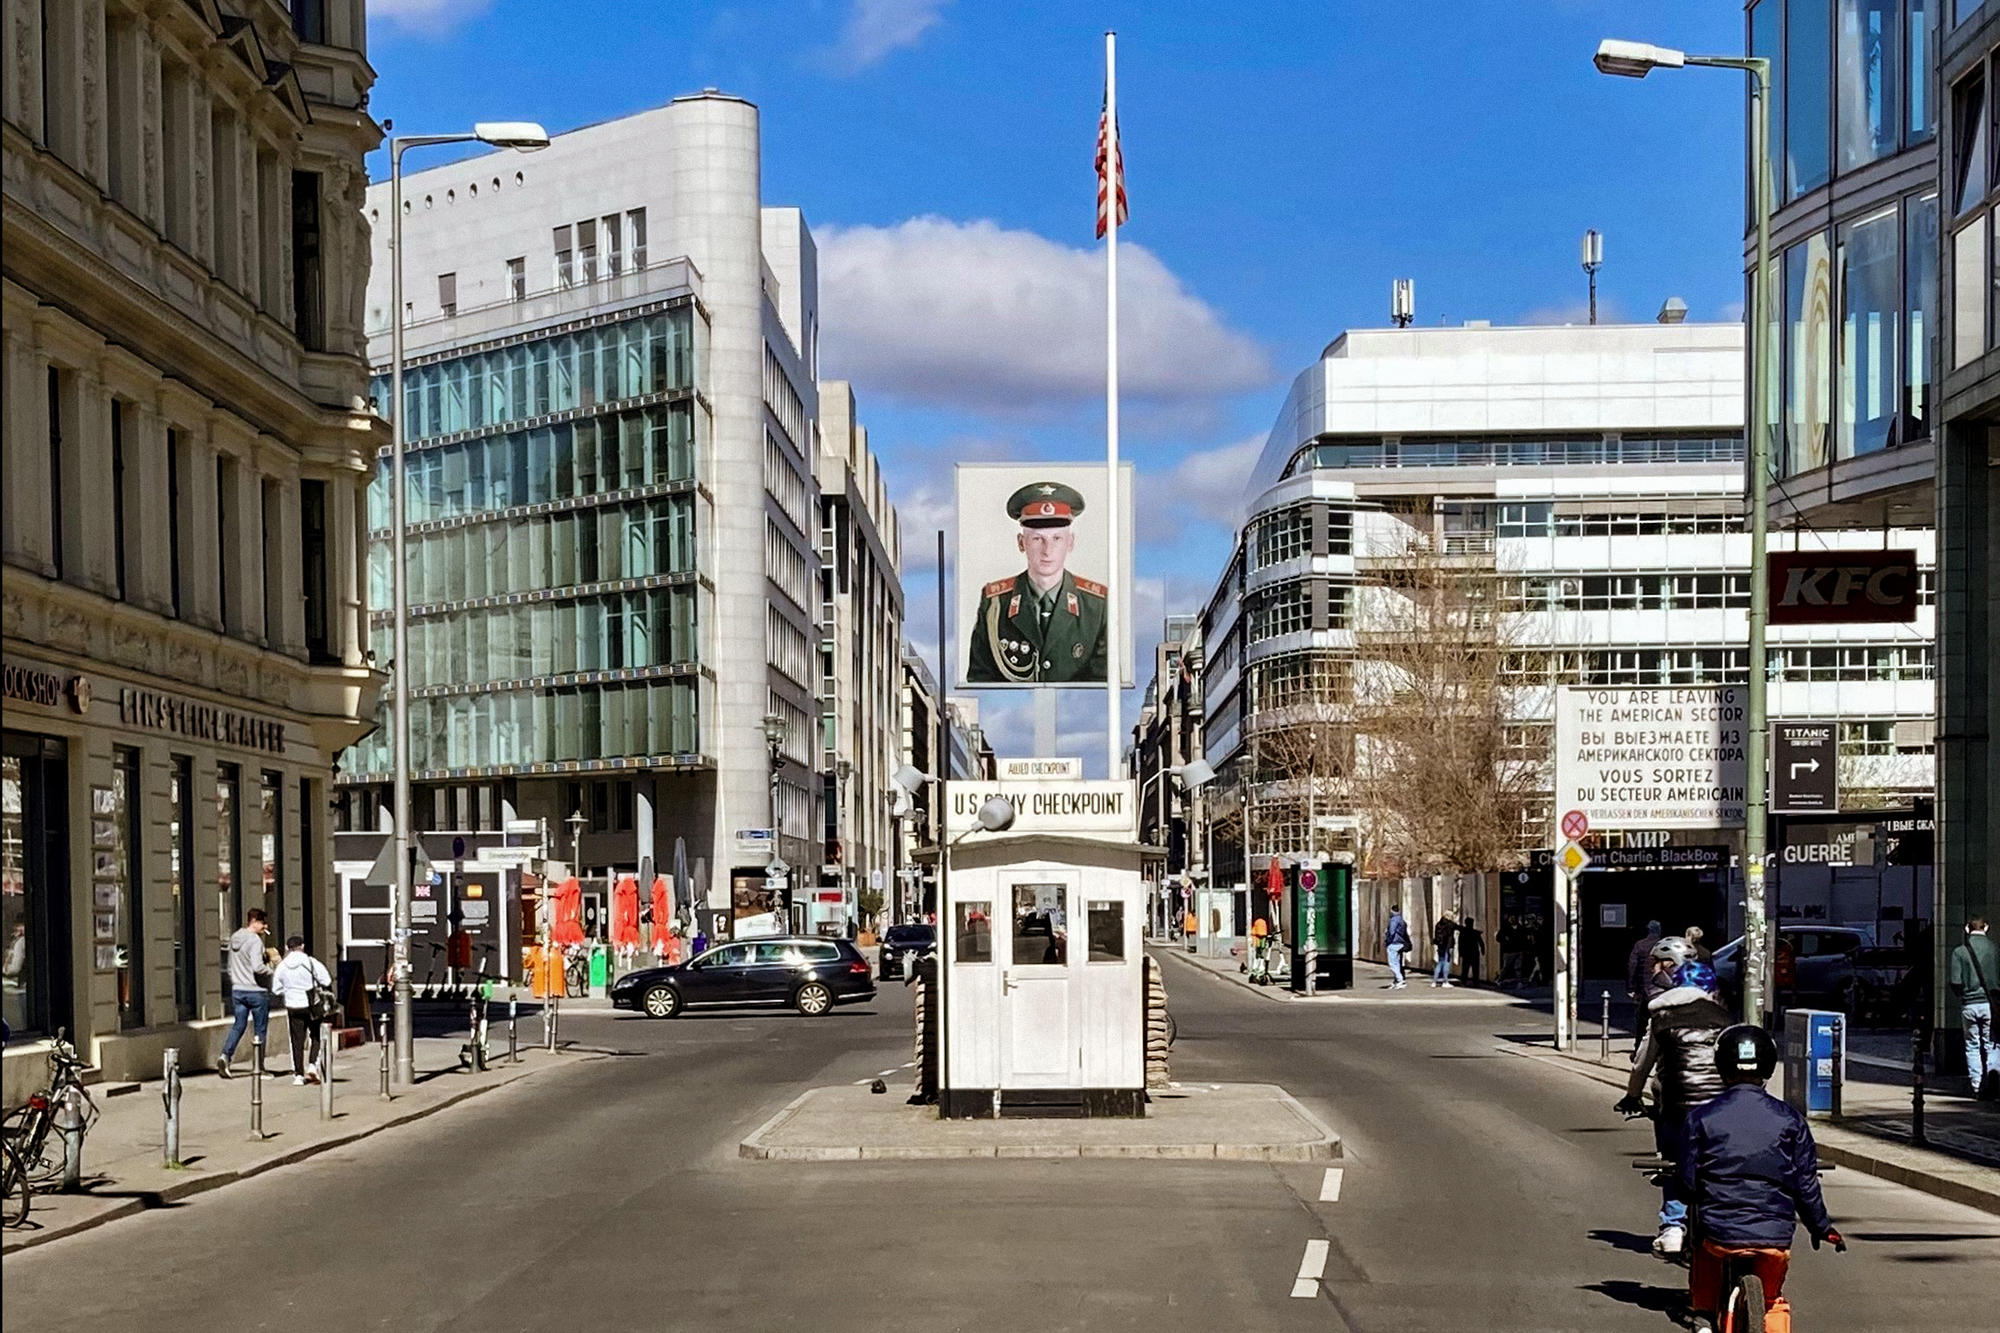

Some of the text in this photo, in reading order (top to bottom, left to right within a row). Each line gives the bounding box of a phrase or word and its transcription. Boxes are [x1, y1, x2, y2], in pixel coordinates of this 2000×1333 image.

[1777, 566, 1908, 606] KFC
[3, 663, 31, 702] OCK
[1588, 689, 1735, 705] YOU ARE LEAVING
[120, 688, 210, 740] EINSTEIN
[1580, 707, 1744, 722] THE AMERICAN SECTOR
[1581, 730, 1740, 745] ВЫ ВЫЕЗЖАЕТЕ ИЗ
[1783, 728, 1829, 737] TITANIC
[1577, 748, 1744, 762] АМЕРИКАНСКОГО СЕКТОРА
[1031, 762, 1070, 775] CHECKPOINT
[1600, 769, 1713, 783] VOUS SORTEZ
[1577, 788, 1595, 802] DU
[1601, 788, 1662, 801] SECTEUR
[955, 793, 964, 815] U
[969, 793, 978, 815] S
[1033, 793, 1123, 815] CHECKPOINT
[1633, 808, 1648, 819] DEN
[1625, 830, 1671, 848] МИР
[1610, 850, 1653, 864] Charlie
[1661, 848, 1719, 863] BlackBox
[1784, 844, 1851, 863] GUERRE
